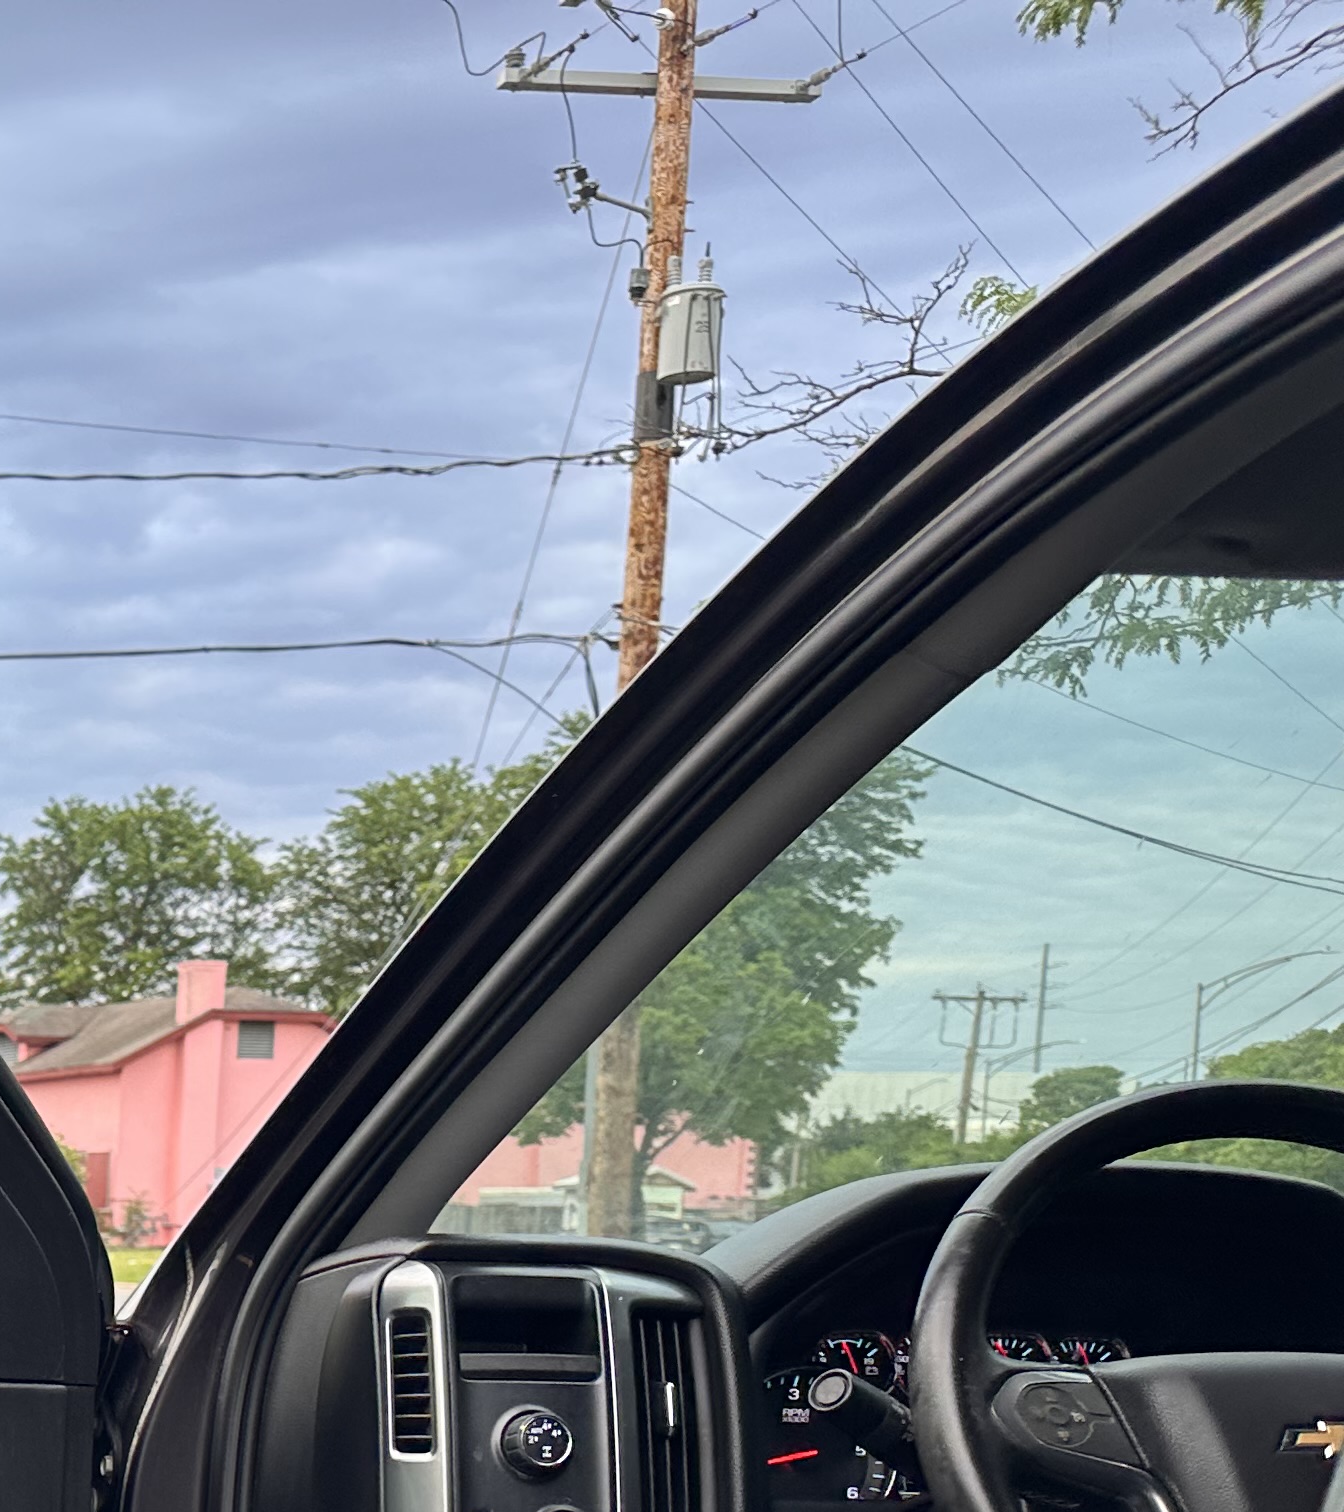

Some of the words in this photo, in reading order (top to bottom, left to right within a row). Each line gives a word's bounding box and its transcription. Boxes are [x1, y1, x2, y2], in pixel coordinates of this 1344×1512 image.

[787, 1389, 800, 1401] 3
[781, 1407, 810, 1418] RPM
[855, 1445, 867, 1457] 5
[846, 1486, 859, 1500] 6
